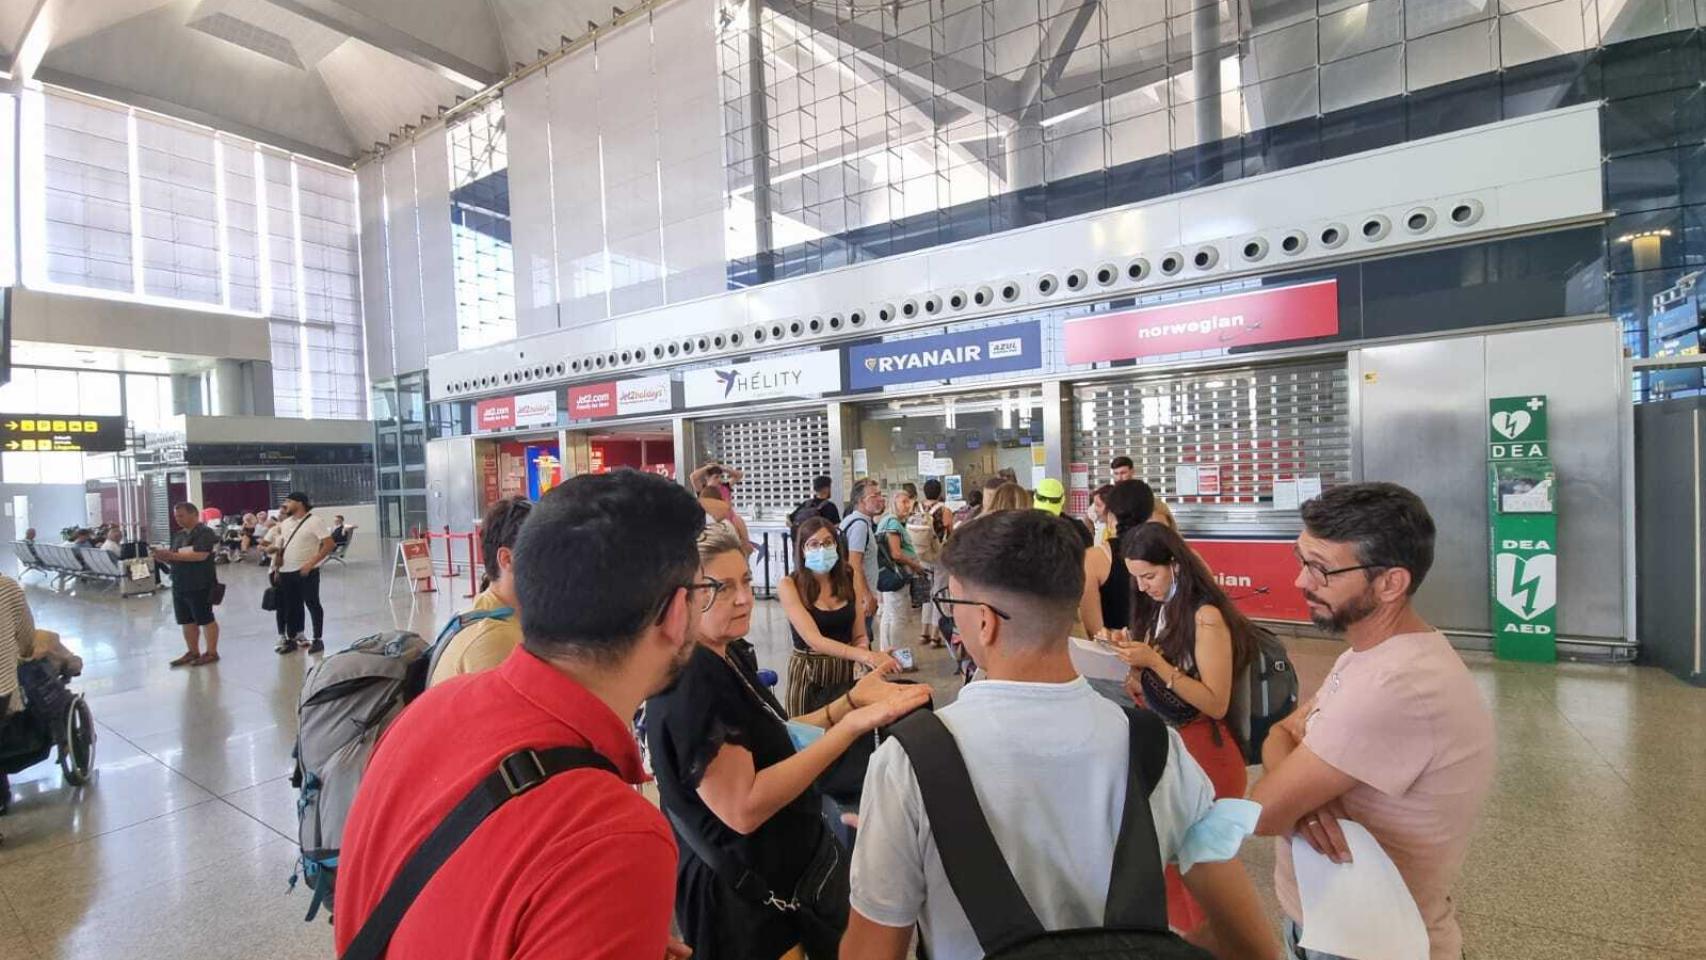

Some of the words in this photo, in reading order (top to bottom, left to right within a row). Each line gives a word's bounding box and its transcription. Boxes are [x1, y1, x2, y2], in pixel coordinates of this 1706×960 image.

[1138, 314, 1244, 339] norwegian
[878, 345, 981, 373] RYANAIR
[738, 370, 802, 391] HÉLITY
[1492, 444, 1543, 458] DEA
[1502, 539, 1551, 550] DEA
[1504, 623, 1551, 634] AED
